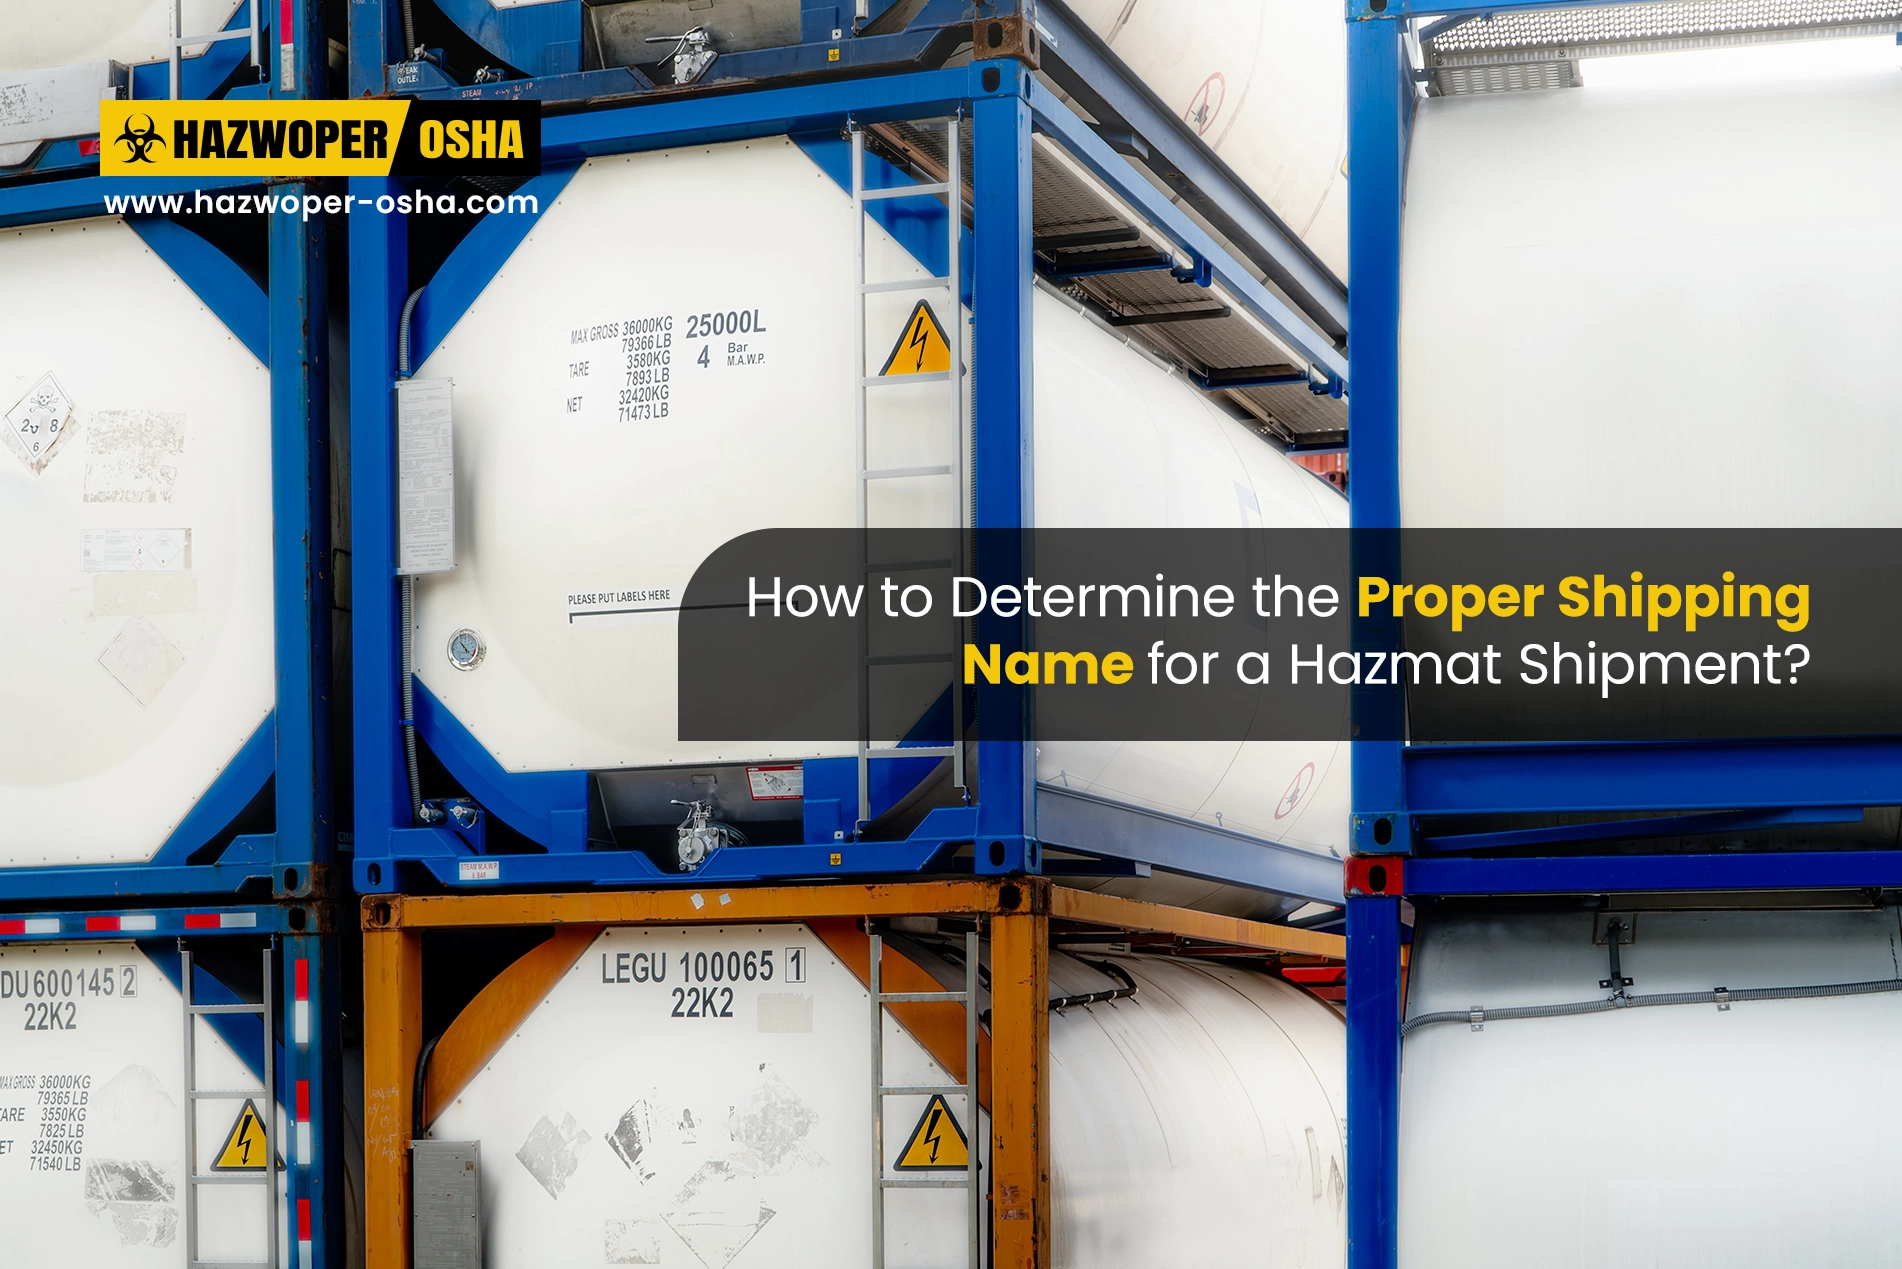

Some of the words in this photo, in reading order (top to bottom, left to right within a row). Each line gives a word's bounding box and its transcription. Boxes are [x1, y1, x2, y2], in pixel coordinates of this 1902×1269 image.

[397, 75, 419, 85] OUTLE
[570, 328, 589, 345] MAX
[589, 322, 619, 341] GROSS
[622, 316, 674, 336] 36000KG
[686, 309, 767, 339] 25000L
[622, 335, 654, 353] 79366
[656, 333, 672, 349] LB
[727, 342, 748, 353] Bar
[569, 361, 590, 378] TARE
[626, 350, 671, 370] 3580KG
[697, 345, 710, 369] 4
[727, 353, 766, 366] M.A.W.P.
[626, 369, 652, 387] 7893
[654, 367, 670, 384] LB
[566, 396, 583, 413] NET
[619, 385, 670, 405] 32420KG
[618, 405, 651, 423] 71473
[653, 401, 669, 418] LB
[33, 442, 40, 452] 6
[568, 594, 597, 605] PLEASE
[598, 592, 615, 603] PUT
[616, 590, 647, 603] LABELS
[648, 589, 671, 601] HERE
[602, 952, 667, 984] LEGU
[679, 950, 774, 983] 100065
[790, 949, 801, 981] 1
[123, 967, 136, 996] 2
[671, 986, 734, 1018] 22K2
[24, 1001, 77, 1031] 22K2
[39, 1075, 91, 1089] 36000KG
[37, 1091, 70, 1105] 79365
[72, 1091, 89, 1105] LB
[41, 1107, 87, 1121] 3550KG
[39, 1124, 66, 1138] 7825
[68, 1124, 85, 1138] LB
[31, 1140, 83, 1154] 32450KG
[30, 1156, 63, 1171] 71540
[65, 1156, 81, 1171] LB
